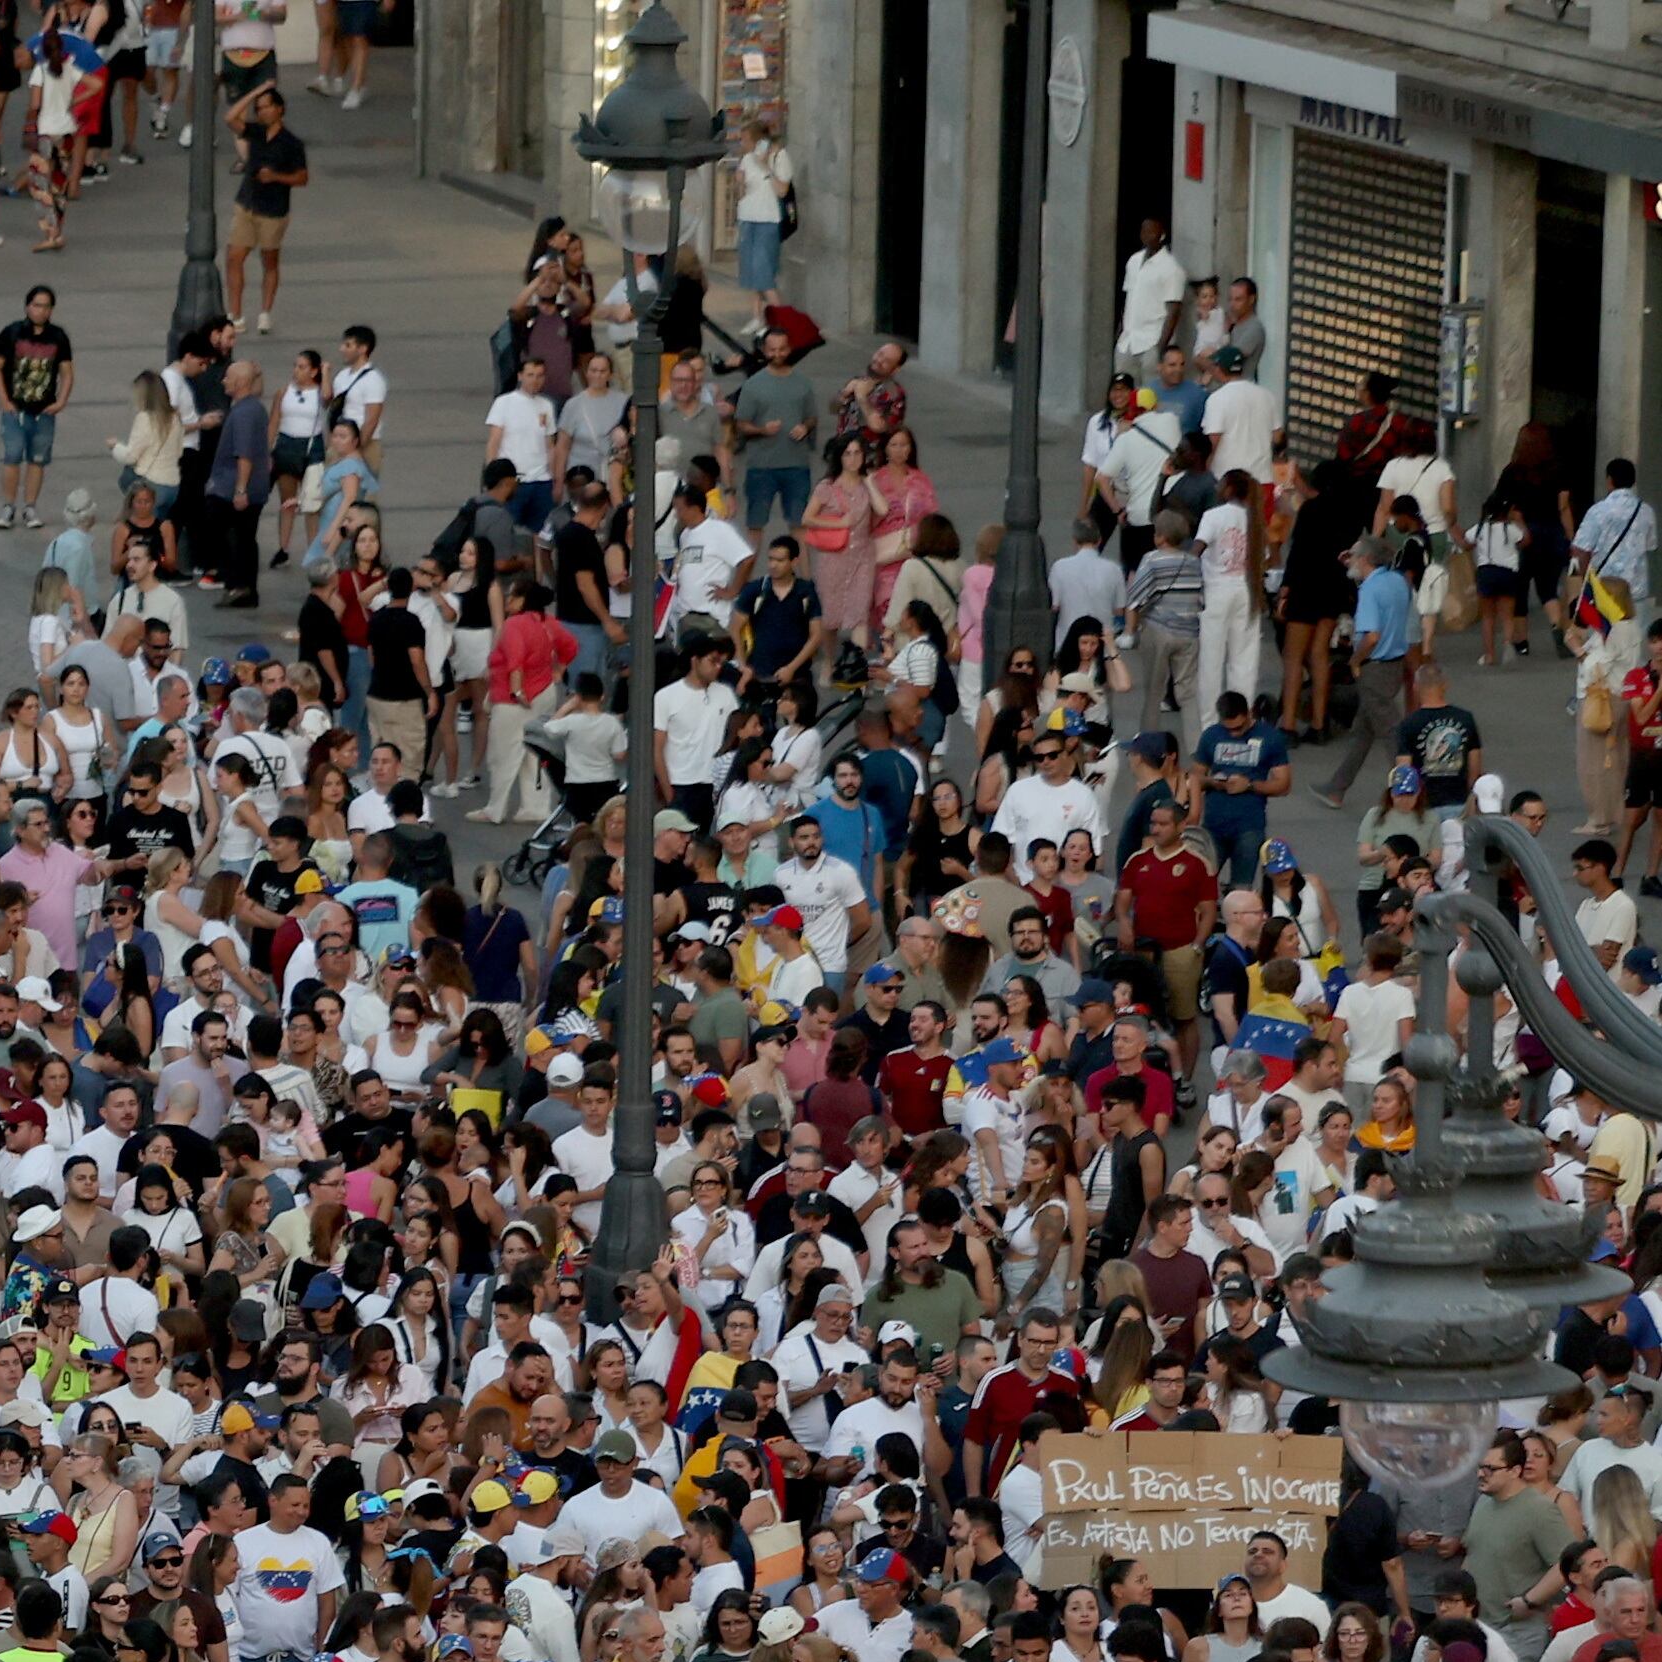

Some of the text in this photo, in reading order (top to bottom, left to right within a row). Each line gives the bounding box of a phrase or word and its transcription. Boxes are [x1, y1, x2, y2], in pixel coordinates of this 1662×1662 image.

[707, 896, 734, 912] JAMES
[63, 1370, 71, 1392] 9
[1128, 1466, 1194, 1502] Peña
[1196, 1475, 1233, 1503] Es
[1160, 1521, 1194, 1551] NO
